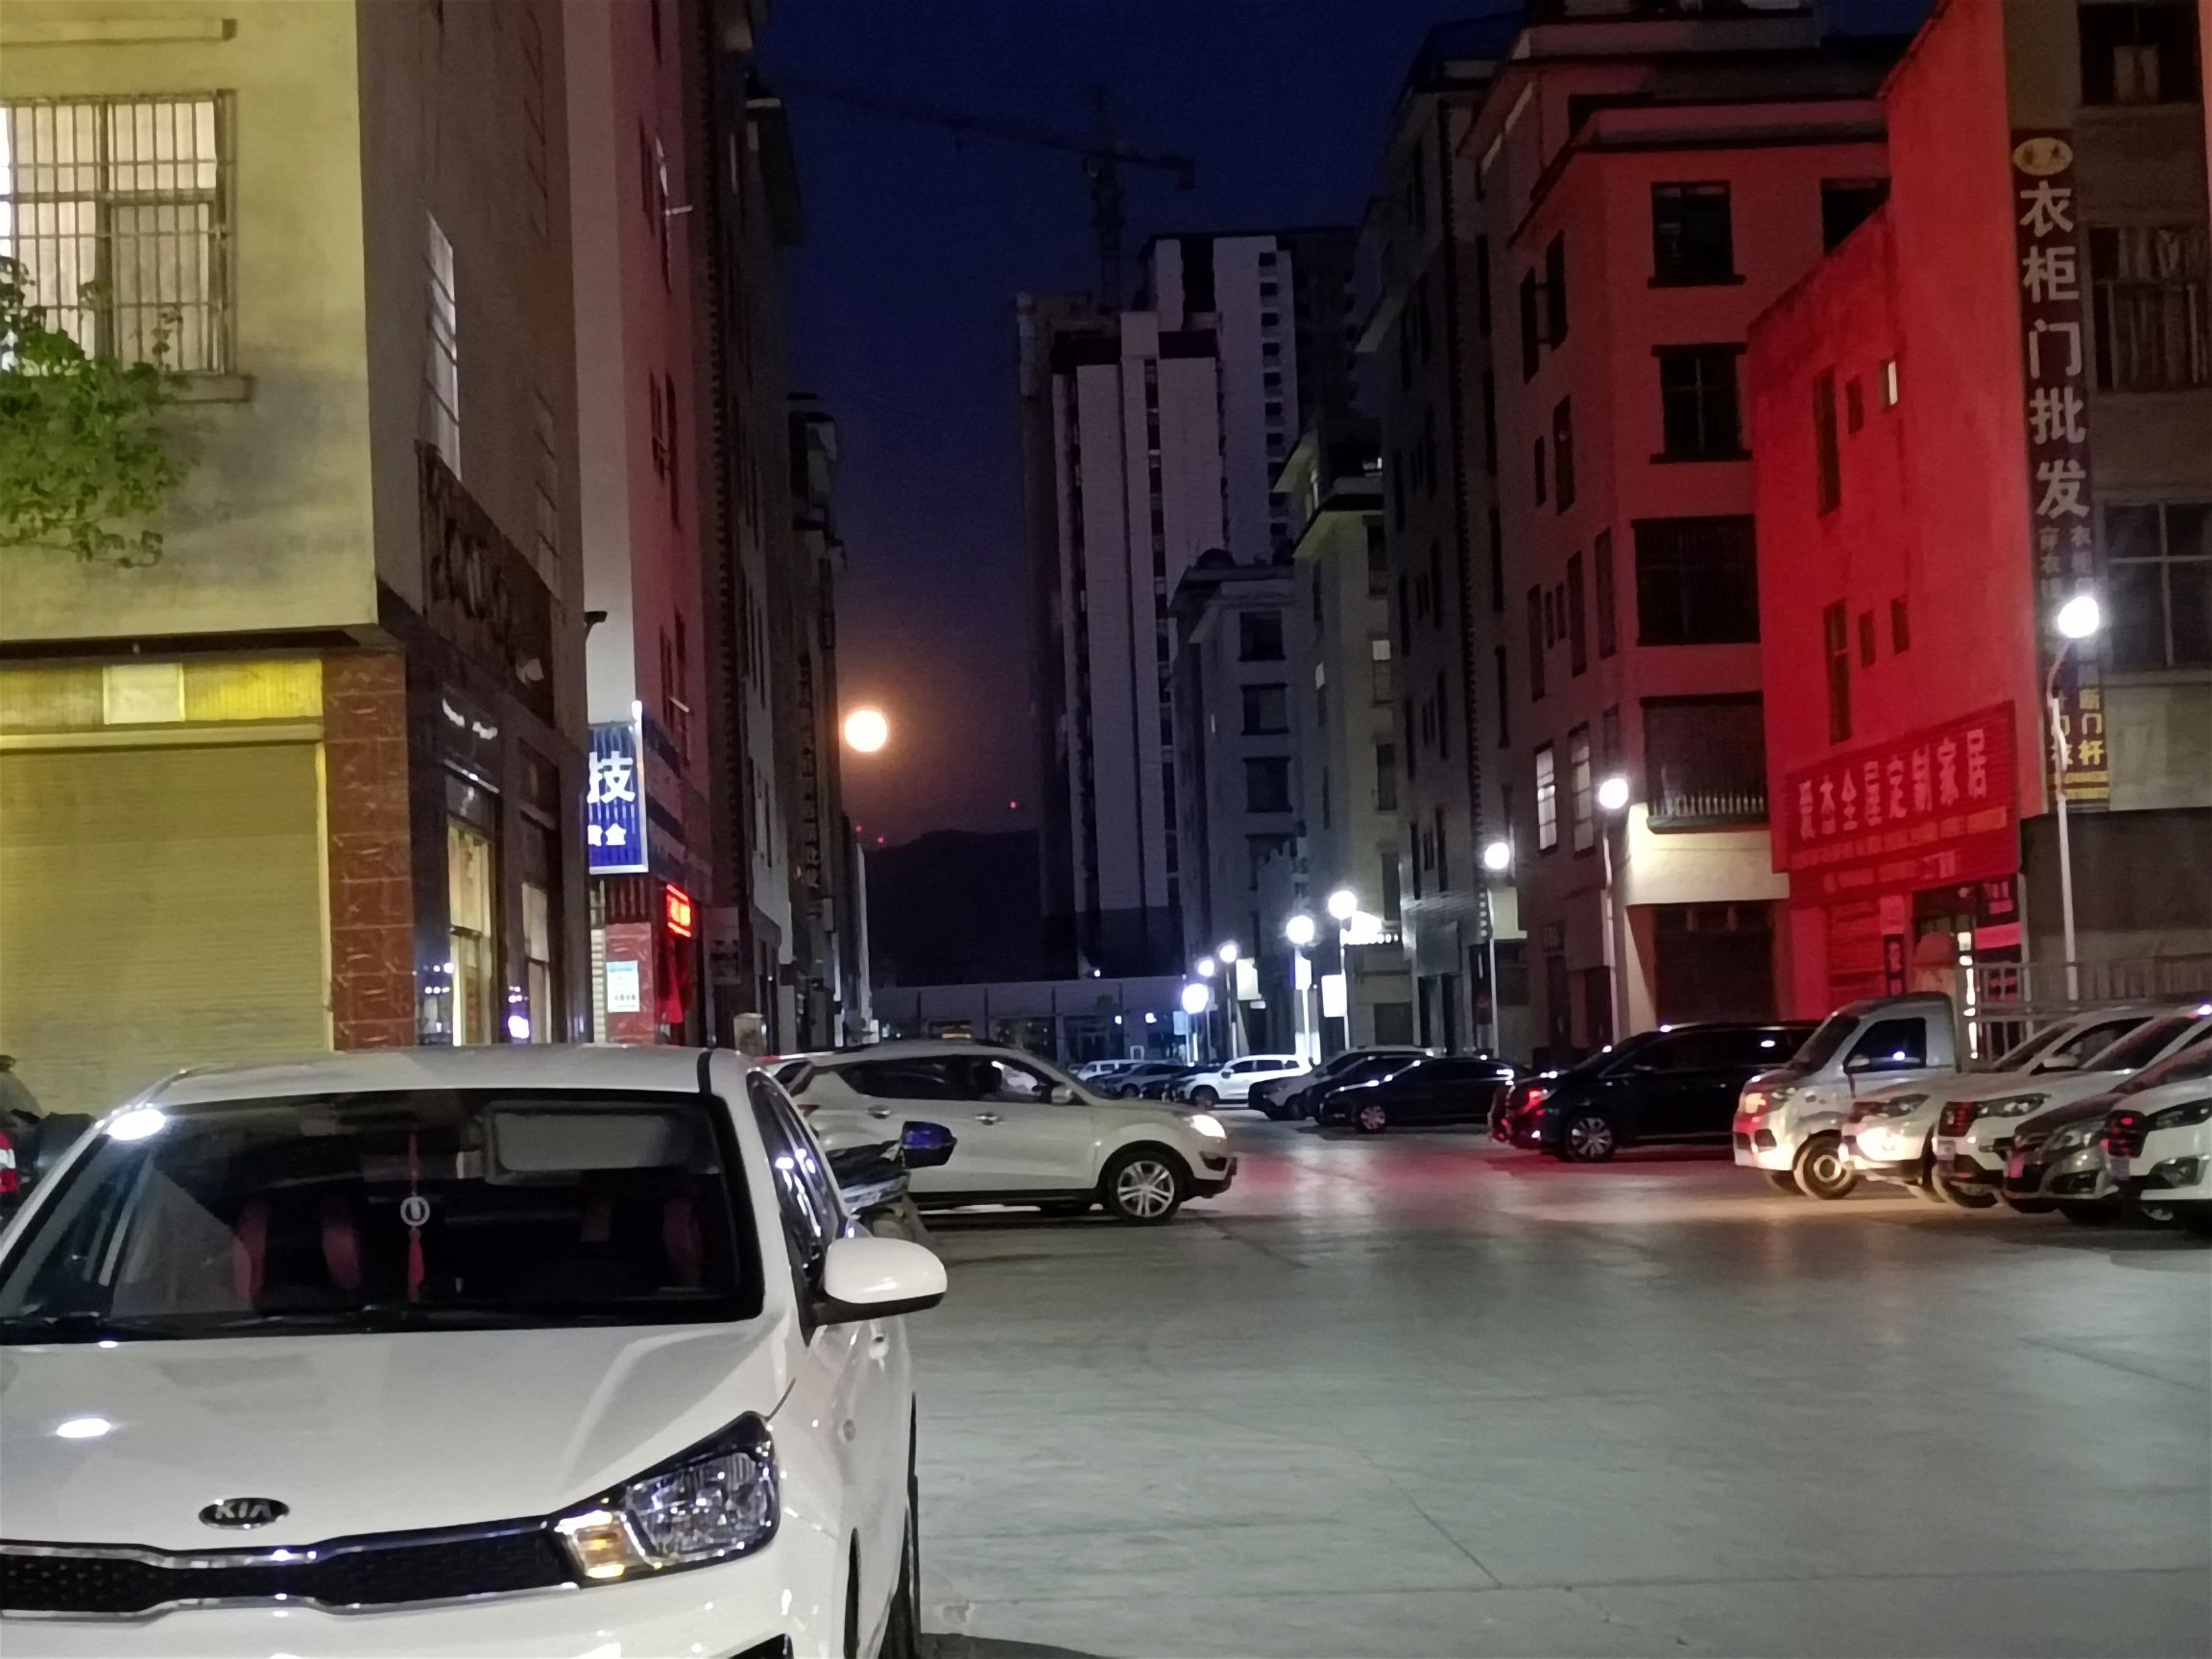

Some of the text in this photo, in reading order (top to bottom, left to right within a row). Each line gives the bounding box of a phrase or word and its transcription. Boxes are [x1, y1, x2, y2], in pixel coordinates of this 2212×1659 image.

[2019, 180, 2090, 518] 衣柜门批发
[214, 1501, 273, 1520] KIA
